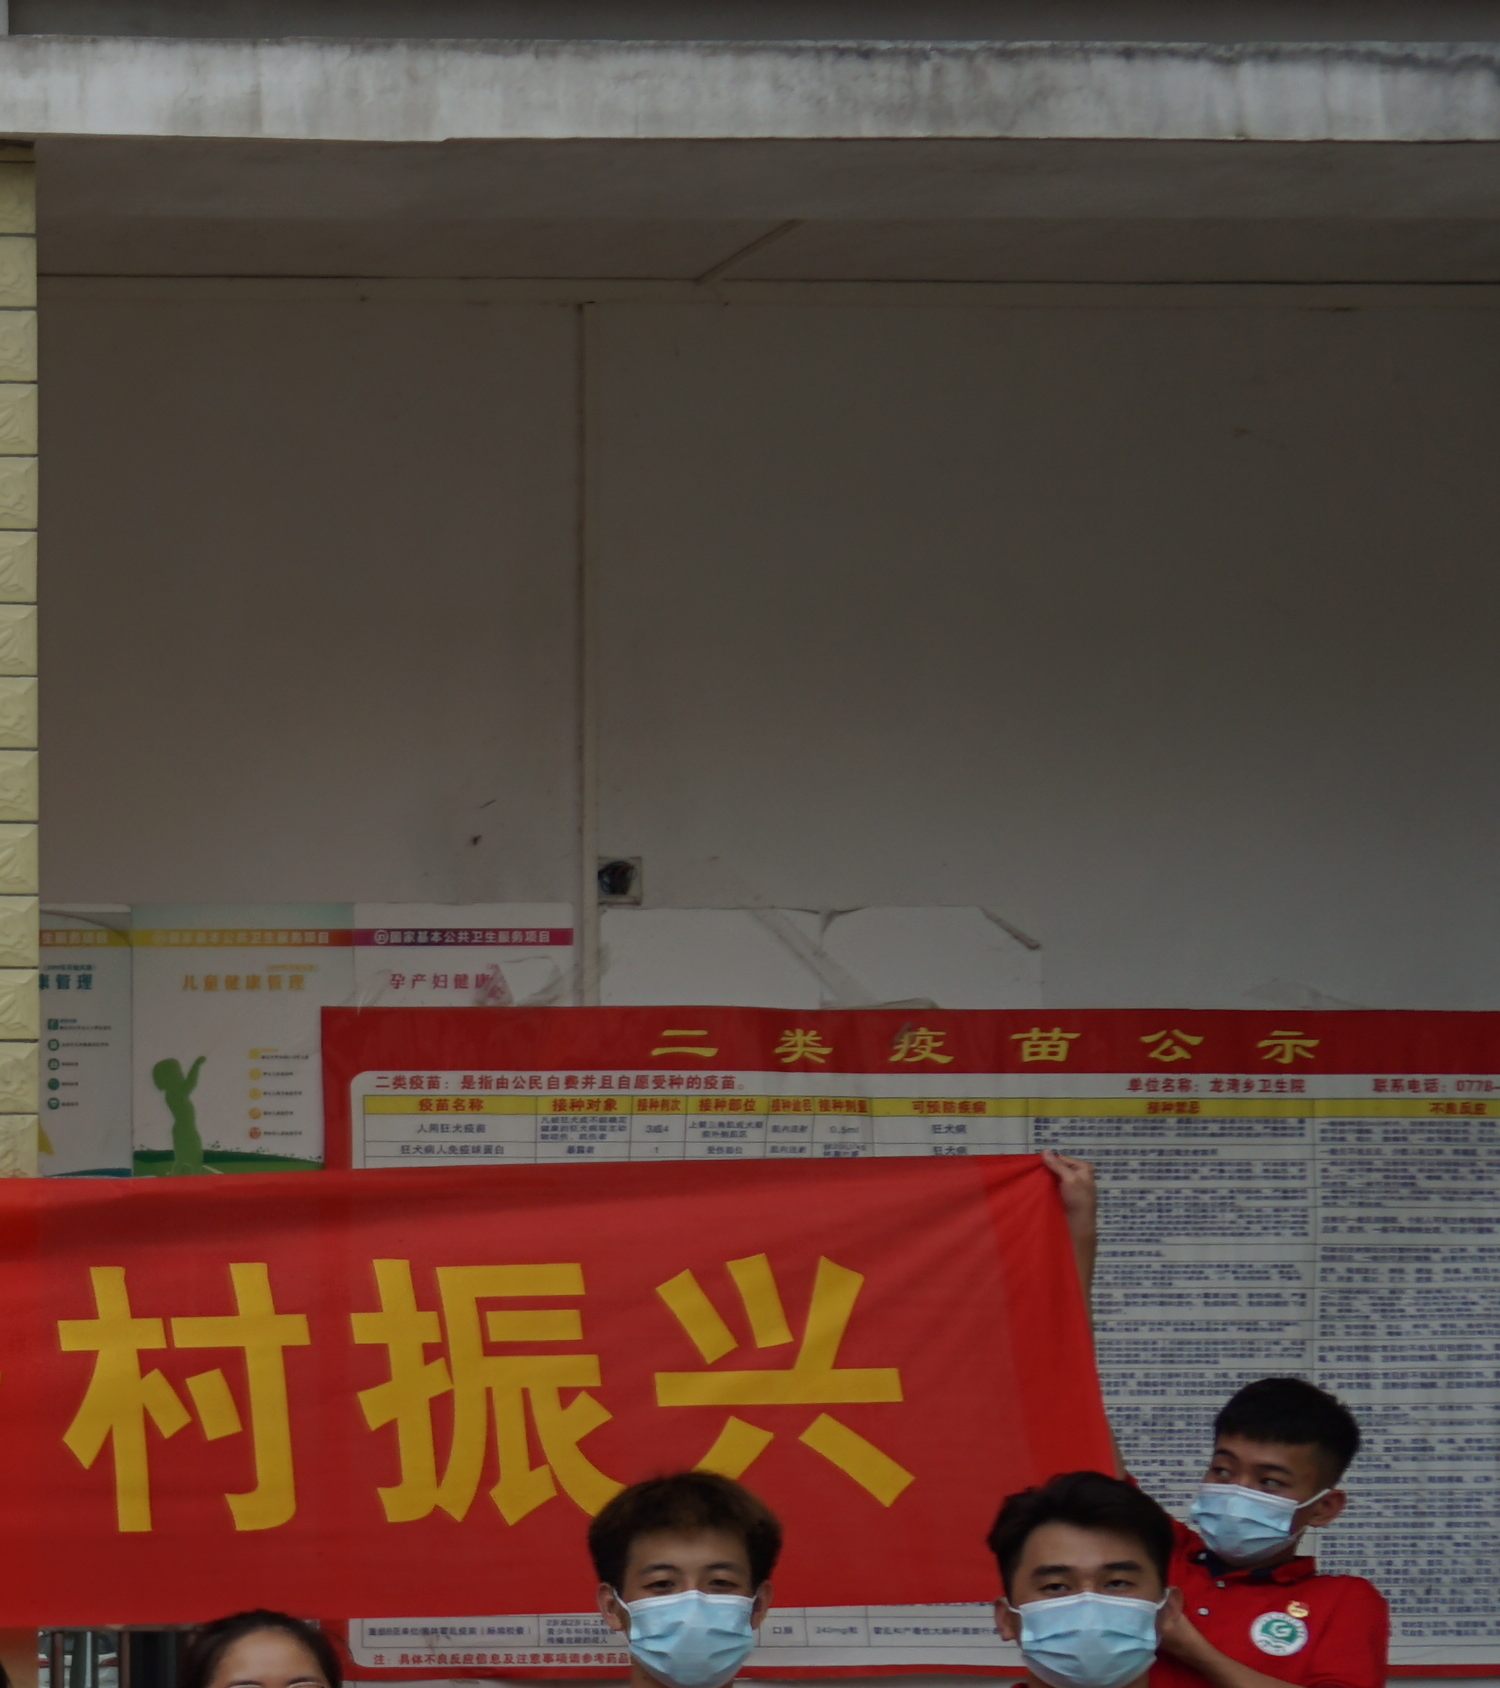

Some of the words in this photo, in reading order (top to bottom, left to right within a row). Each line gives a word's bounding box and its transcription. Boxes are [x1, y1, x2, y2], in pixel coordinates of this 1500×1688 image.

[390, 931, 550, 943] 国家基本公共卫生服务项目
[182, 974, 305, 991] 儿童健康管理
[651, 1027, 1320, 1065] 二类疫苗公示
[1126, 1078, 1306, 1094] 单位名称：龙湾乡卫生院
[418, 1098, 484, 1112] 疫苗名称
[552, 1098, 618, 1112] 接种对象
[699, 1099, 756, 1112] 接种部位
[818, 1099, 868, 1113] 接种剂量
[911, 1100, 987, 1114] 可预防疾病
[417, 1123, 487, 1135] 人用狂犬疫苗
[931, 1124, 967, 1135] 狂犬病
[373, 1653, 632, 1665] 注：具体不良反应信息及注意事项请参考药品
